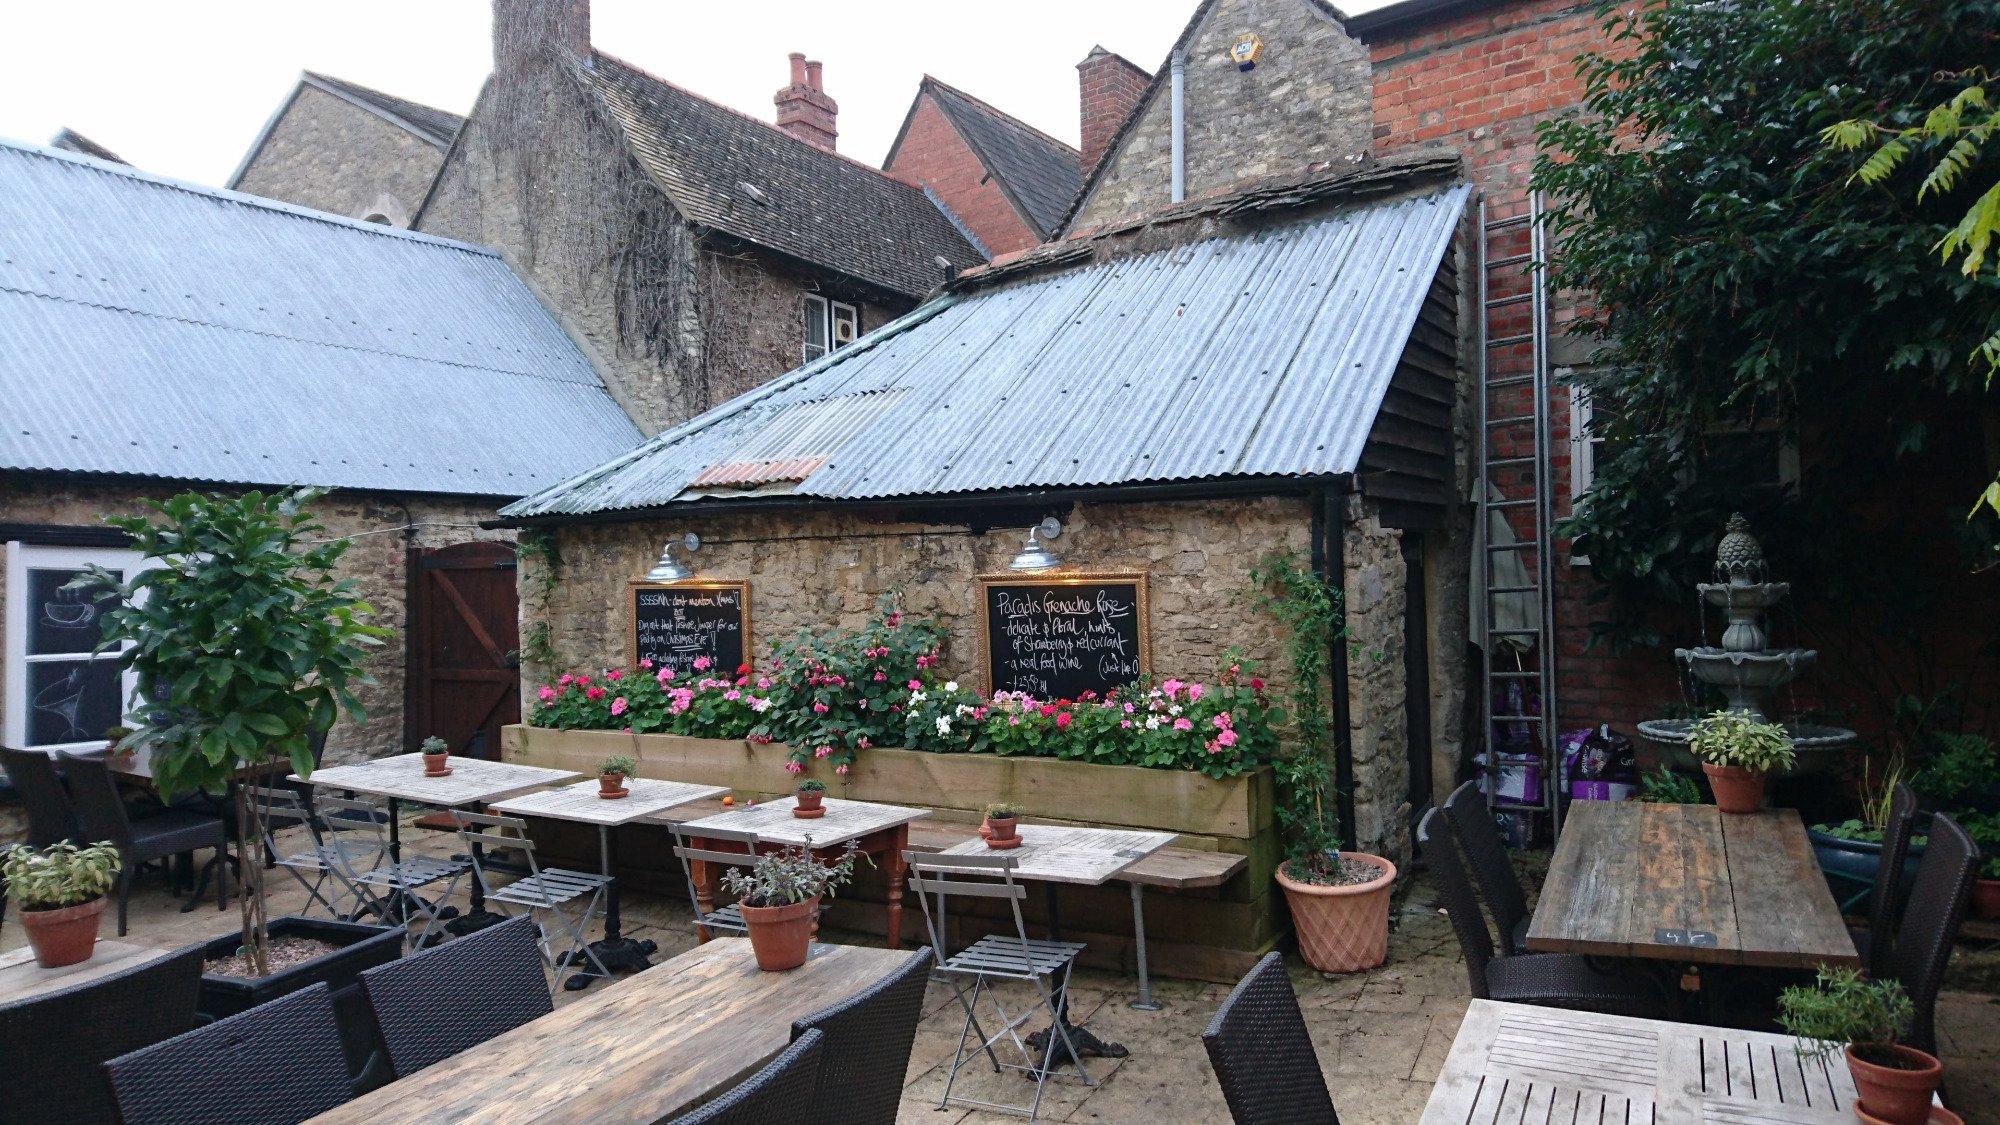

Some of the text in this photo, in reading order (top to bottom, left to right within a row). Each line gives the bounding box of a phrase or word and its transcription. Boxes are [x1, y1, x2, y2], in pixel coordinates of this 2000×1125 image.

[997, 592, 1041, 616] Paradis
[1043, 591, 1095, 617] Grenache
[717, 618, 728, 632] for
[1012, 636, 1023, 654] of
[1020, 653, 1039, 670] real
[1040, 653, 1057, 676] food
[1059, 657, 1082, 670] wine
